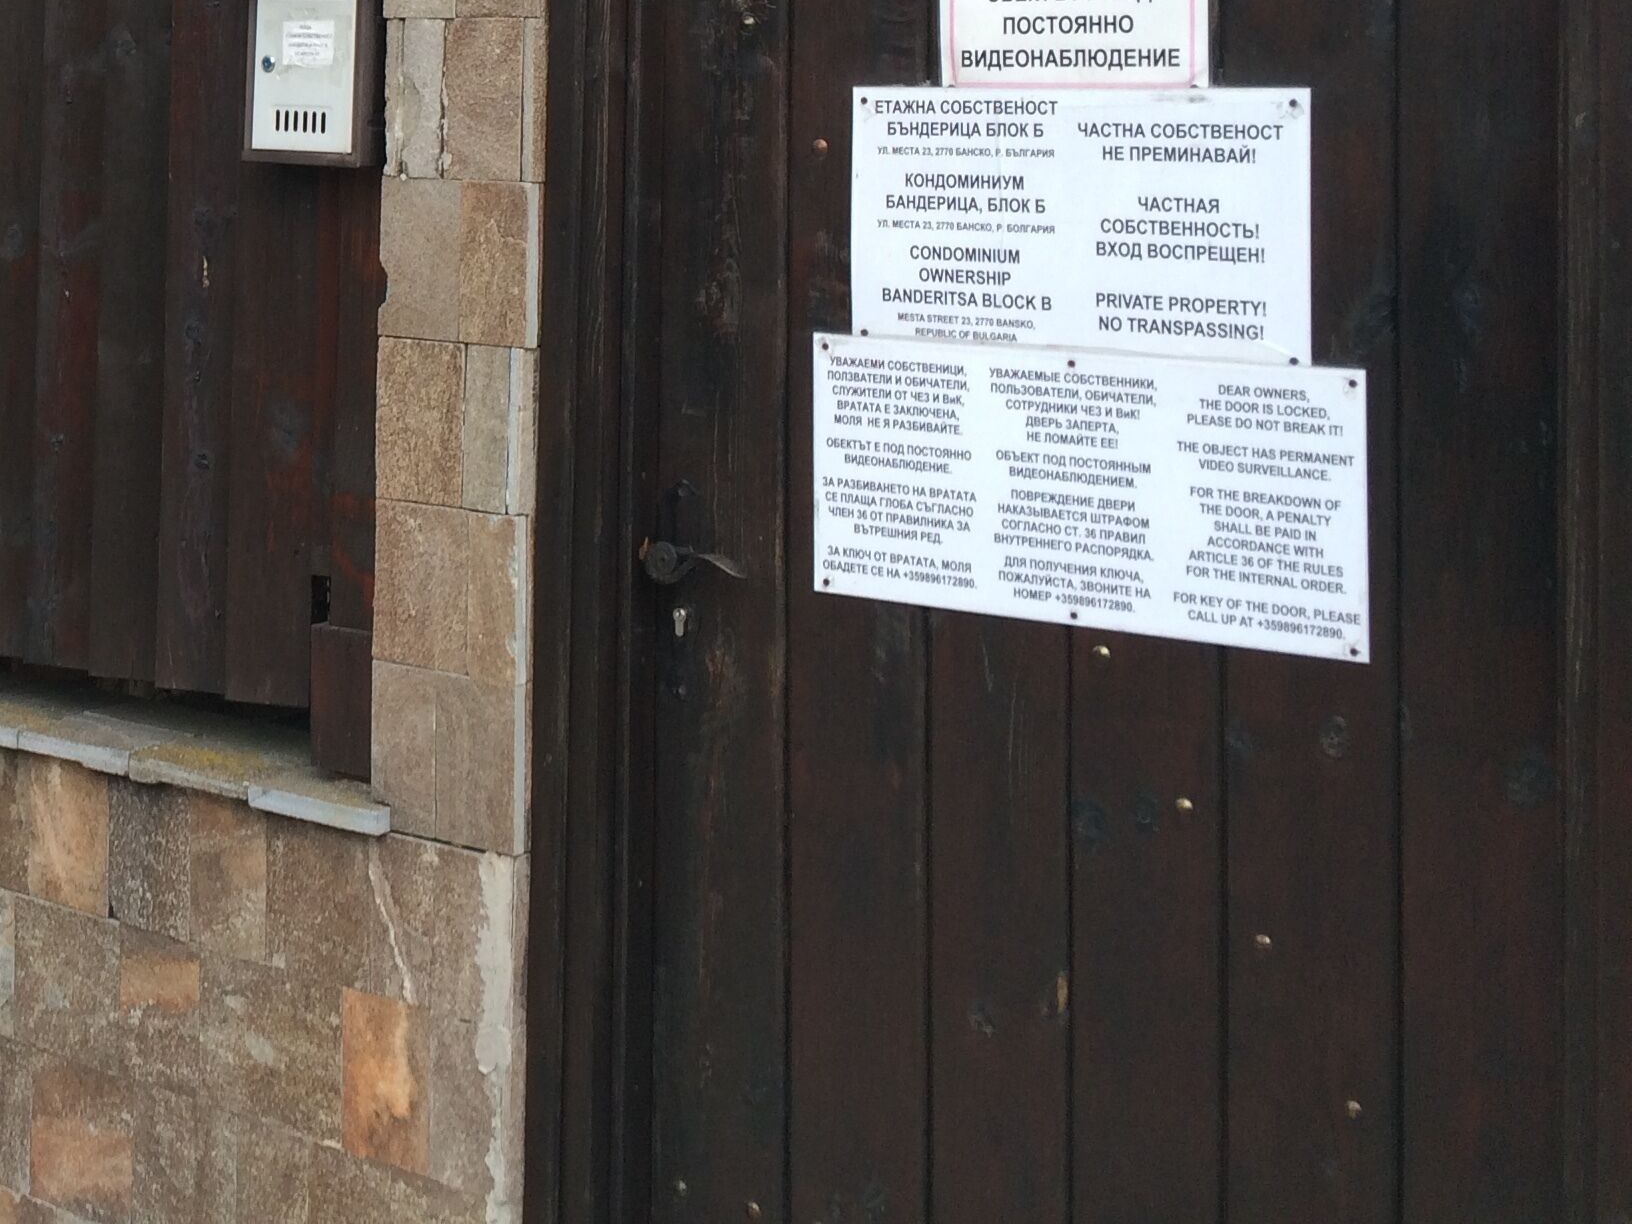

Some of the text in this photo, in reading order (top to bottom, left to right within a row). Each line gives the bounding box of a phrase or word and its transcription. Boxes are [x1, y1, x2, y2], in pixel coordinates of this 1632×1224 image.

[1003, 14, 1134, 34] ПОСТОЯННО
[961, 48, 1180, 70] ВИДЕОНАБЛЮДЕНИЕ
[874, 99, 1058, 114] ЕТАЖНА СОБСТВЕНОСТ
[887, 121, 1044, 138] БЪНДЕРИЦА БЛОК Б
[1077, 122, 1283, 140] ЧАСТНА СОБСТВЕНОСТ
[1102, 145, 1255, 163] НЕ ПРЕМИНАВАЙ!
[905, 173, 1024, 190] КОНДОМИНИУМ
[885, 194, 1045, 213] БАНДЕРИЦА, БЛОК Б
[1137, 196, 1219, 213] ЧАСТНАЯ
[1100, 218, 1259, 238] СОБСТВЕННОСТЬ!
[909, 245, 1020, 263] CONDOMINIUM
[1096, 241, 1264, 264] ВХОД ВОСПРЕЩЕН!
[918, 267, 1011, 285] OWNERSHIP
[882, 287, 1052, 310] BANDERITSA BLOCK B
[1095, 292, 1266, 316] PRIVATE PROPERTY!
[897, 312, 958, 324] MESTA STREET
[1098, 315, 1263, 340] NO TRANSPASSING!
[914, 327, 1017, 342] REPUBLIC OF BULGARIA
[829, 355, 885, 369] УВАЖАЕМИ
[827, 370, 902, 385] ПОЛЗВАТЕЛИ И
[989, 367, 1060, 382] УВАЖАЕМЫЕ
[831, 385, 939, 402] СЛУЖИТЕЛИ ОТ ЧЕЗ И
[1218, 384, 1250, 396] DEAR
[836, 399, 890, 413] ВРАТАТА Е
[1005, 398, 1112, 417] СОТРУДНИКИ ЧЕЗ И
[1200, 398, 1221, 410] THE
[1224, 400, 1259, 413] DOOR
[1262, 403, 1273, 414] IS
[833, 413, 890, 428] МОЛЯ НЕ Я
[1025, 416, 1062, 428] ДВЕРЬ
[1186, 413, 1343, 435] PLEASE DO NOT BREAK IT!
[826, 437, 972, 460] ОБЕКТЪТ Е ПОД ПОСТОЯННО
[1026, 431, 1118, 448] НЕ ЛОМАЙТЕ ЕЕ!
[995, 449, 1151, 473] ОБЪЕКТ ПОД ПОСТОЯННЫМ
[1177, 440, 1354, 466] THE OBJECT HAS PERMANENT
[1198, 458, 1234, 472] VIDEO
[822, 476, 976, 501] ЗА РАЗБИВАНЕТО НА ВРАТАТА
[1189, 486, 1341, 510] FOR THE BREAKDOWN OF
[824, 491, 974, 517] СЕ ПЛАЩА ГЛОБА СЪГЛАСНО
[1010, 488, 1135, 511] ПОВРЕЖДЕНИЕ ДВЕРИ
[828, 505, 970, 531] ЧЛЕН 36 ОТ ПРАВИЛНИКА ЗА
[997, 502, 1149, 528] НАКАЗЫВАЕТСЯ ШТРАФОМ
[1199, 502, 1222, 515] THE
[1265, 509, 1274, 520] A
[1276, 510, 1331, 526] PENALTY
[853, 523, 917, 540] ВЪТРЕШНИЯ
[1001, 518, 1145, 544] СОГЛАСНО 36 ПРАВИЛ
[1213, 520, 1316, 541] SHALL BE PAID IN
[993, 532, 1072, 551] ВНУТРЕННЕГО
[1207, 536, 1324, 558] ACCORDANCE WITH
[822, 559, 900, 578] ОБАДЕТЕ СЕ НА
[827, 545, 971, 573] ЗА КЛЮЧ ОТ МОЛЯ
[1003, 555, 1026, 568] ДЛЯ
[1029, 558, 1097, 576] ПОЛУЧЕНИЯ
[1188, 550, 1343, 577] ARTICLE 36 OF THE RULES
[1185, 565, 1297, 588] FOR THE INTERNAL
[1013, 587, 1052, 602] НОМЕР
[1079, 579, 1131, 596] ЗВОНИТЕ
[1134, 586, 1151, 598] НА
[1173, 591, 1197, 604] FOR
[1199, 594, 1223, 607] KEY
[1225, 598, 1242, 609] OF
[1245, 600, 1268, 613] THE
[1313, 608, 1360, 625] PLEASE
[1187, 609, 1253, 627] CALL UP AT
